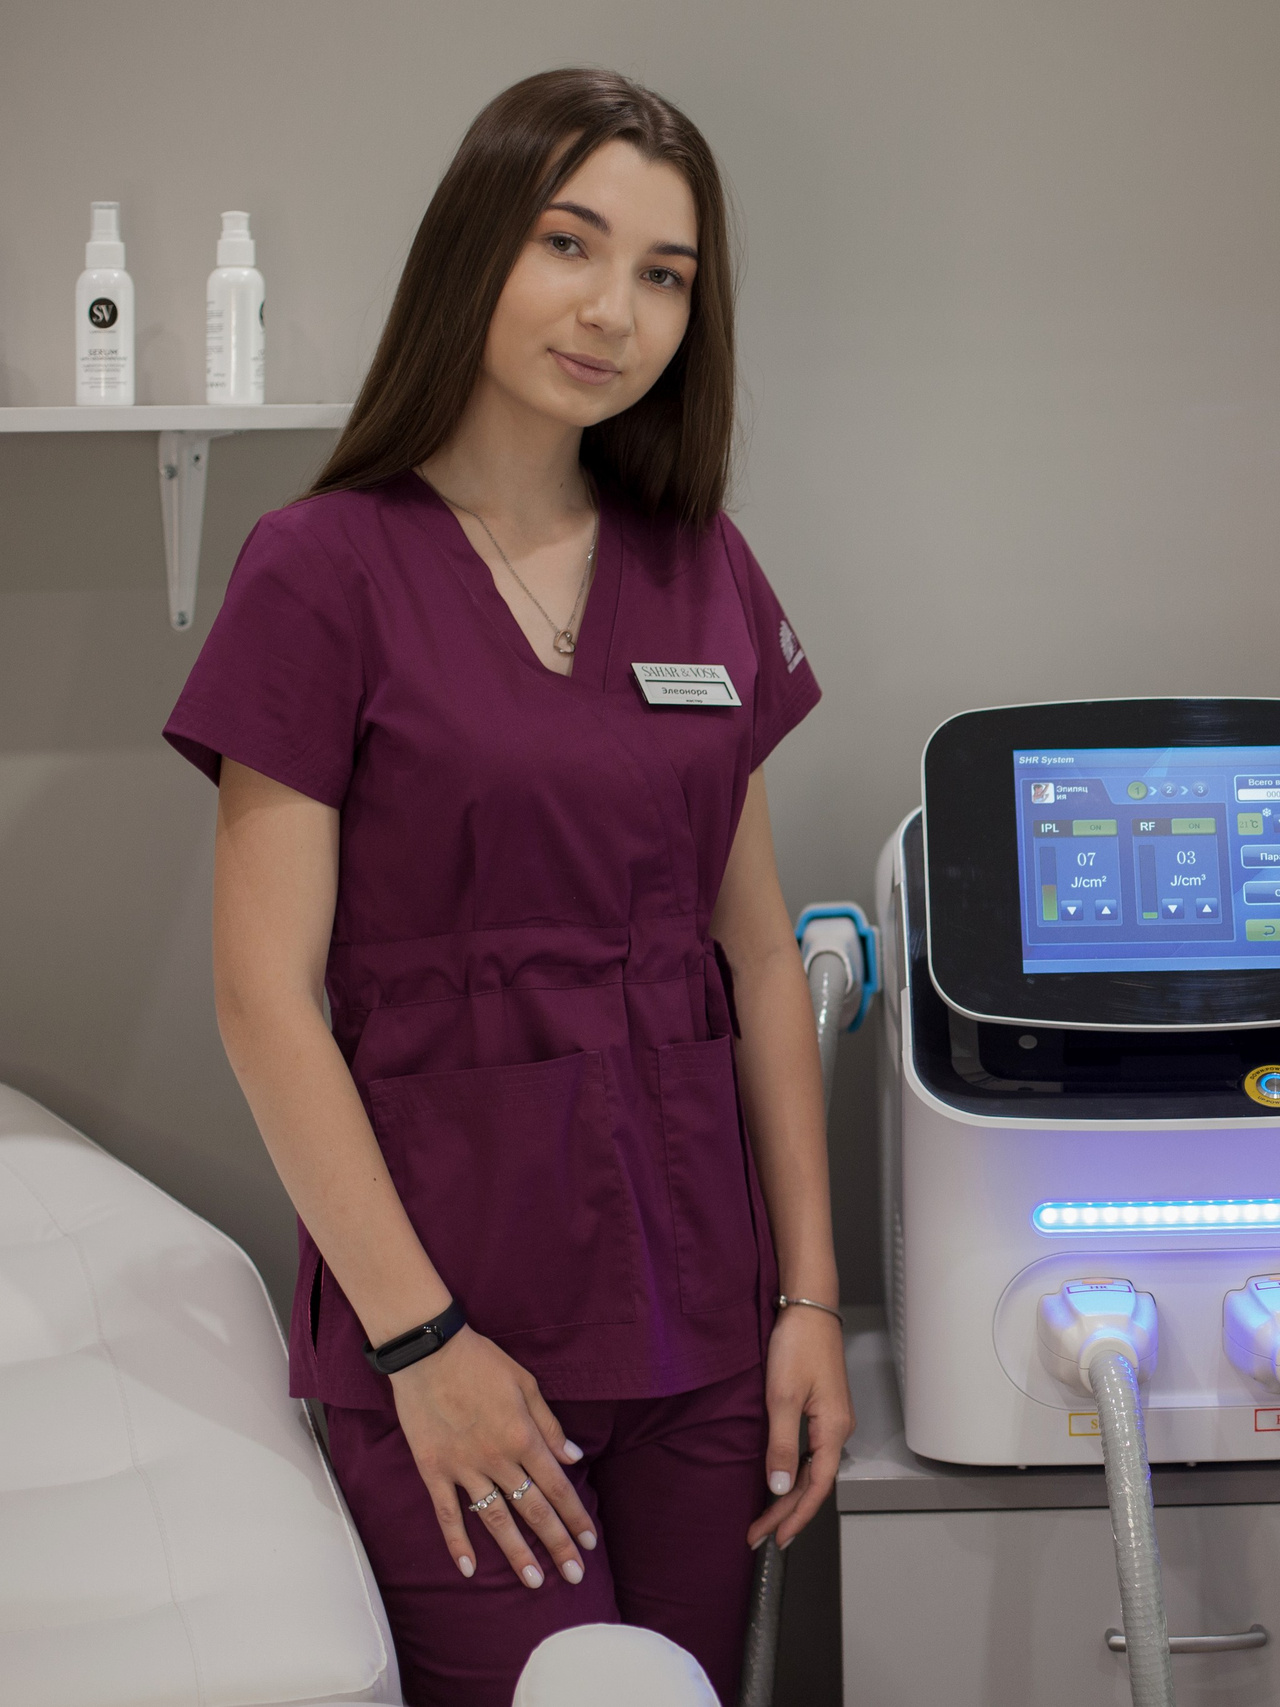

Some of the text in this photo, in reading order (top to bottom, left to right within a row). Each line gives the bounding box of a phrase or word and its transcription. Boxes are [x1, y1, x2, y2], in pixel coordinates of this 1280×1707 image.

[92, 304, 114, 323] SV
[641, 665, 720, 679] SAHAR & VOSK
[661, 686, 708, 696] Элеонора
[1018, 756, 1075, 765] SHR System
[1248, 778, 1273, 786] Всего
[1166, 785, 1172, 794] 2
[1197, 785, 1204, 794] 3
[1041, 823, 1060, 833] IPL
[1139, 821, 1156, 832] RF
[1077, 852, 1096, 867] 07
[1176, 850, 1196, 865] 03
[1090, 1418, 1099, 1430] S
